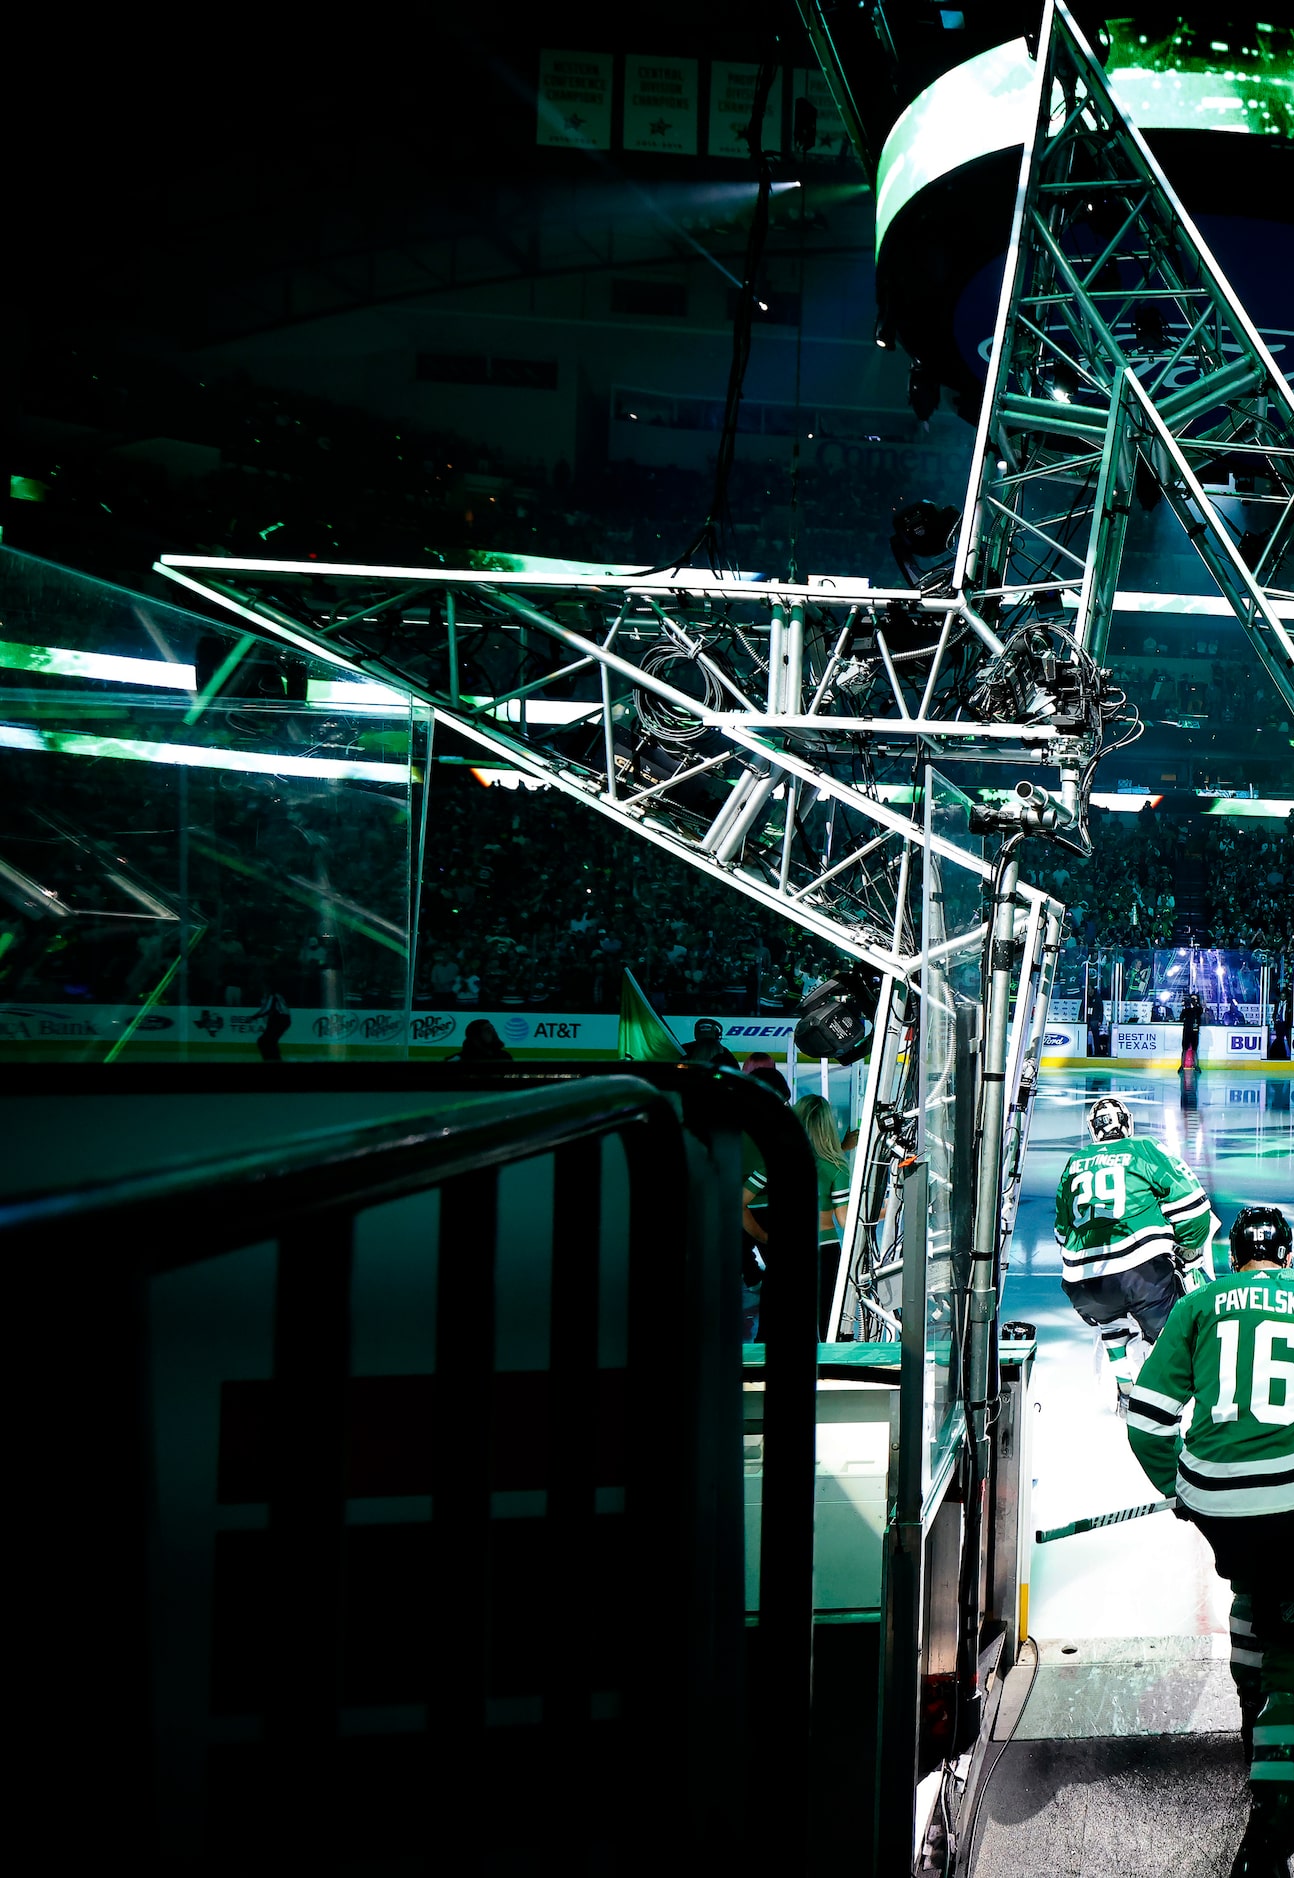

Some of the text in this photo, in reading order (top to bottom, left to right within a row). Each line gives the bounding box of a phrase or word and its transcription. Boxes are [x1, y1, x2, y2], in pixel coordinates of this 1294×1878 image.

[638, 66, 684, 81] CENTRAL
[410, 1015, 452, 1040] Dr Pepper
[534, 1022, 581, 1039] AT&T
[1118, 1033, 1143, 1041] BEST
[1118, 1041, 1157, 1050] TEXAS
[1069, 1153, 1132, 1175] OETTINGER
[1070, 1165, 1126, 1229] 29
[1252, 1227, 1265, 1242] 16
